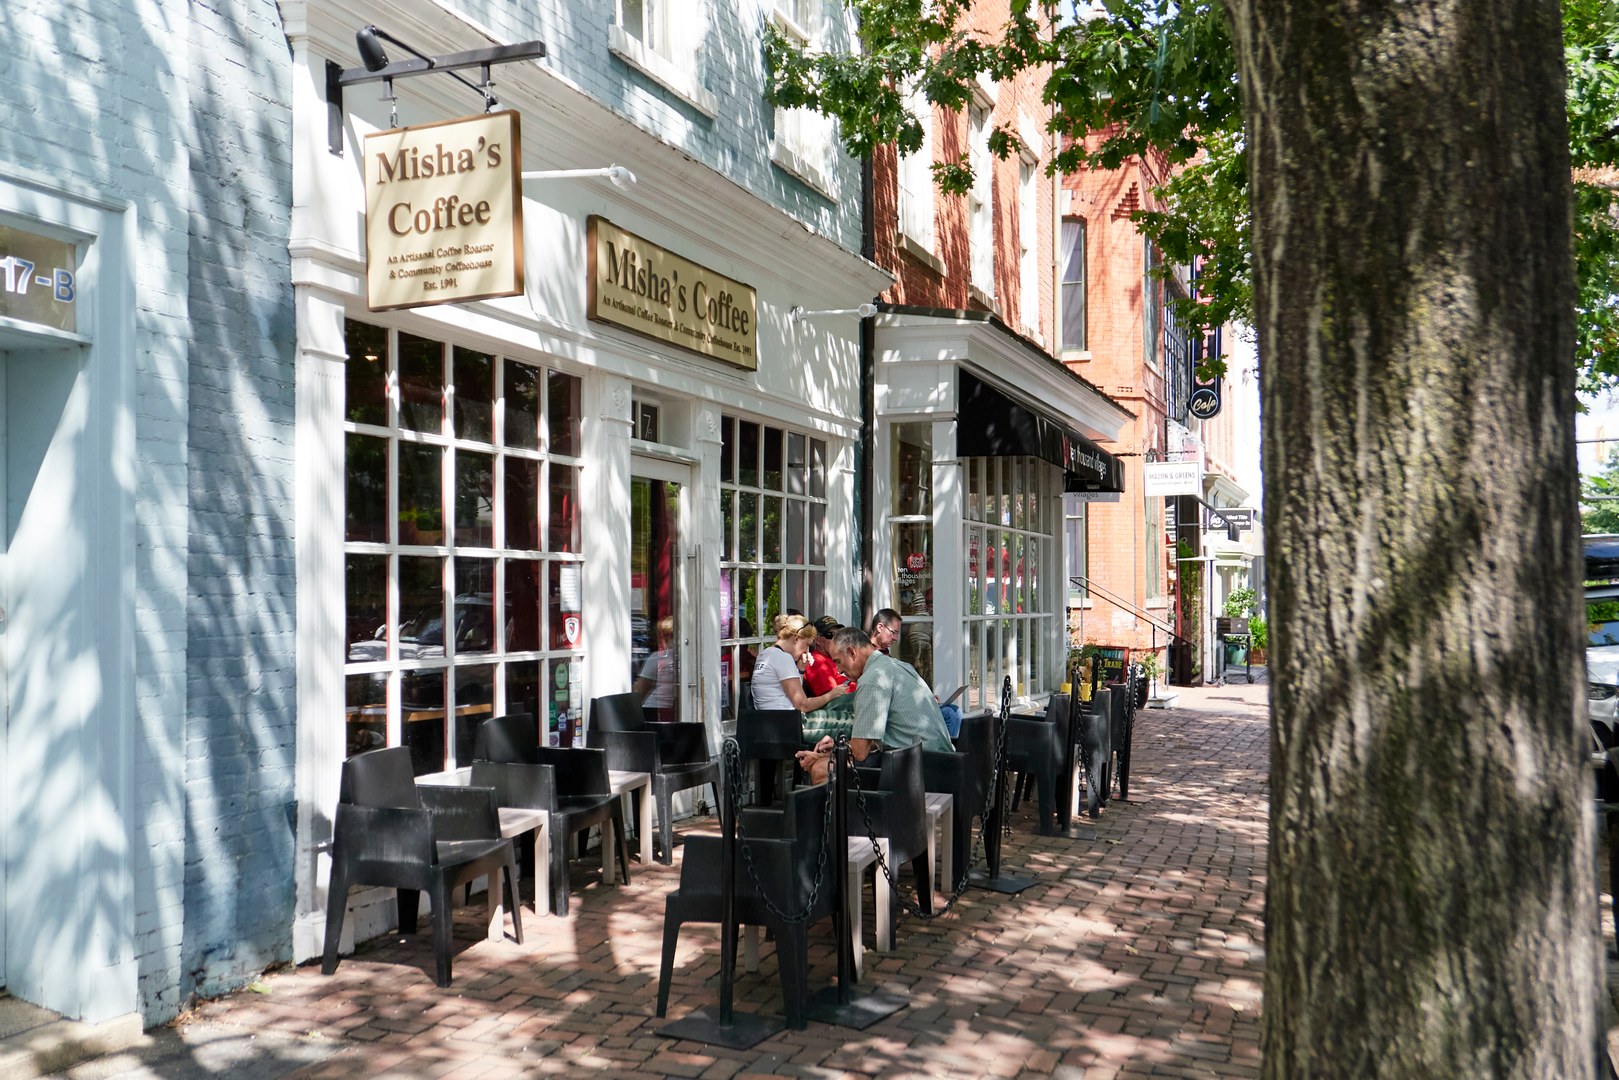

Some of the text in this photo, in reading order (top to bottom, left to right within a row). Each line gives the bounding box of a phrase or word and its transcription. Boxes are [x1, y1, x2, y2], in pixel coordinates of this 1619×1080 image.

[376, 135, 502, 186] Misha's
[387, 194, 492, 238] Coffee
[387, 243, 495, 265] An Artisanal Coffee Roaster
[388, 258, 493, 280] & Community Coffeehouse
[422, 278, 459, 291] Est. 1991
[606, 240, 750, 336] Misha's Coffee
[602, 295, 611, 305] An
[612, 298, 637, 316] Artisanal
[637, 307, 654, 322] Coffee
[654, 313, 673, 329] Roaster
[674, 320, 679, 331] &
[679, 323, 706, 344] Community
[706, 333, 733, 350] Coffeehouse
[733, 342, 742, 353] Est.
[1192, 395, 1217, 412] Cafe
[1069, 441, 1107, 481] ten thousand villages
[1175, 471, 1196, 480] GREENS
[1073, 492, 1099, 500] villages
[893, 577, 916, 587] villages
